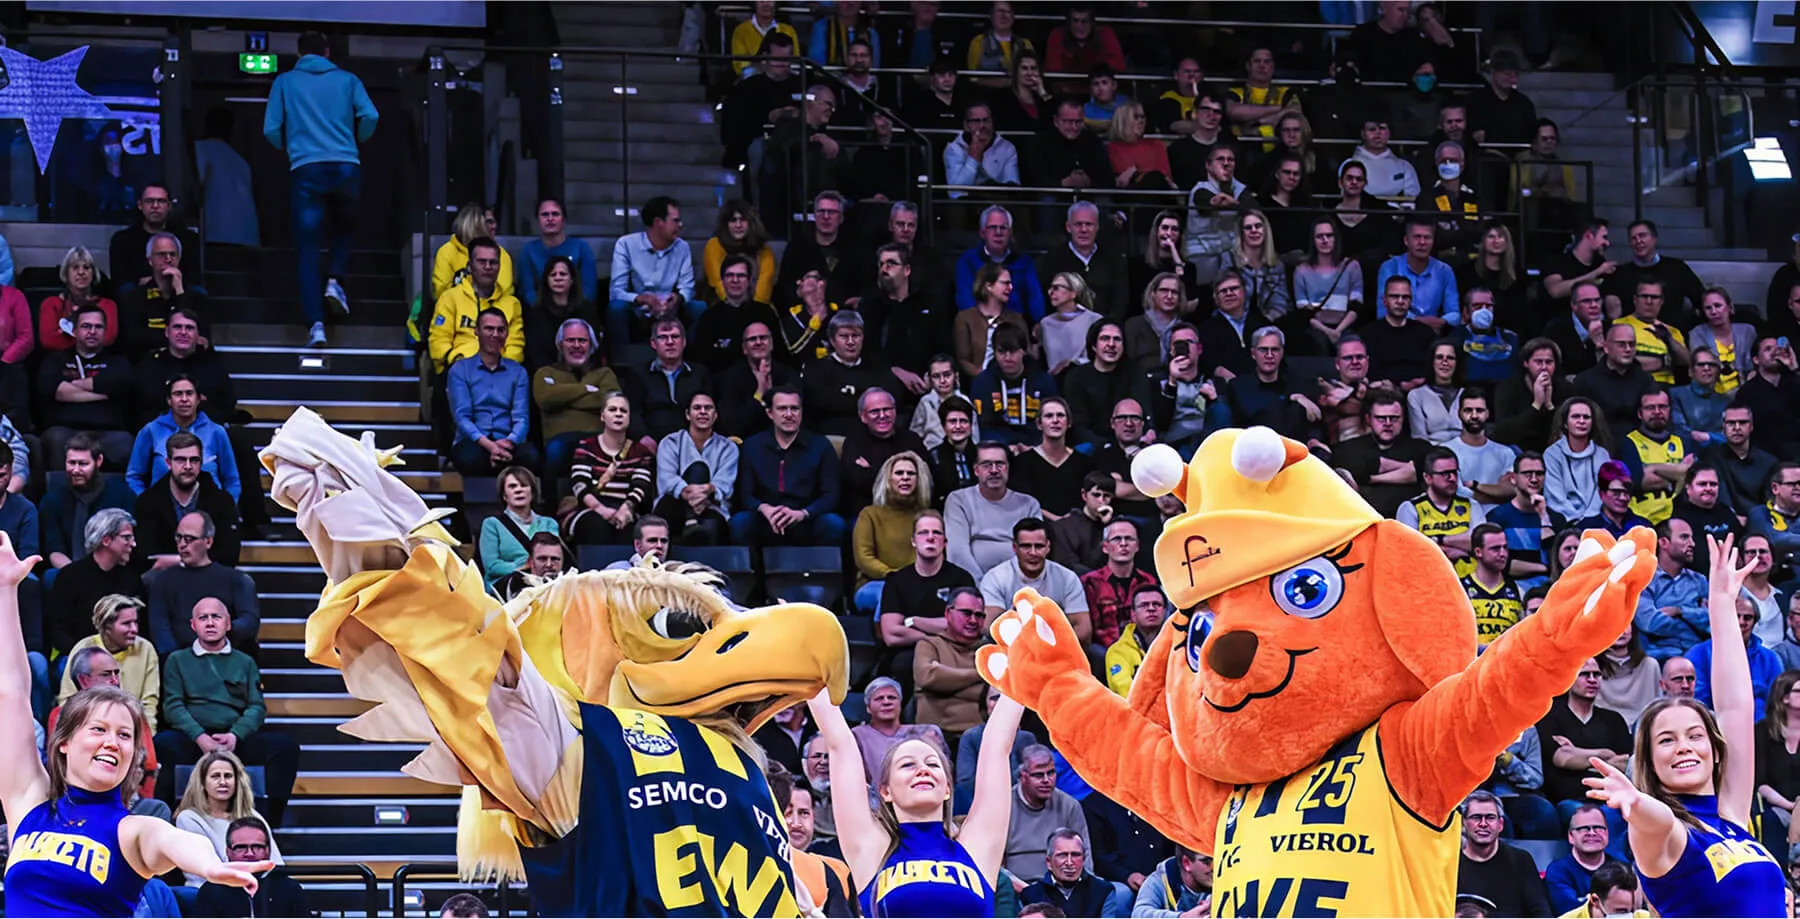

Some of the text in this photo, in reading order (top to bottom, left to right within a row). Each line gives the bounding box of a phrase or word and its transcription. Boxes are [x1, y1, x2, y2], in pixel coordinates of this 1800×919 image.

[628, 780, 728, 810] SEMCO
[1295, 752, 1365, 812] 25
[1270, 832, 1376, 856] VIEROL
[653, 824, 799, 917] EW
